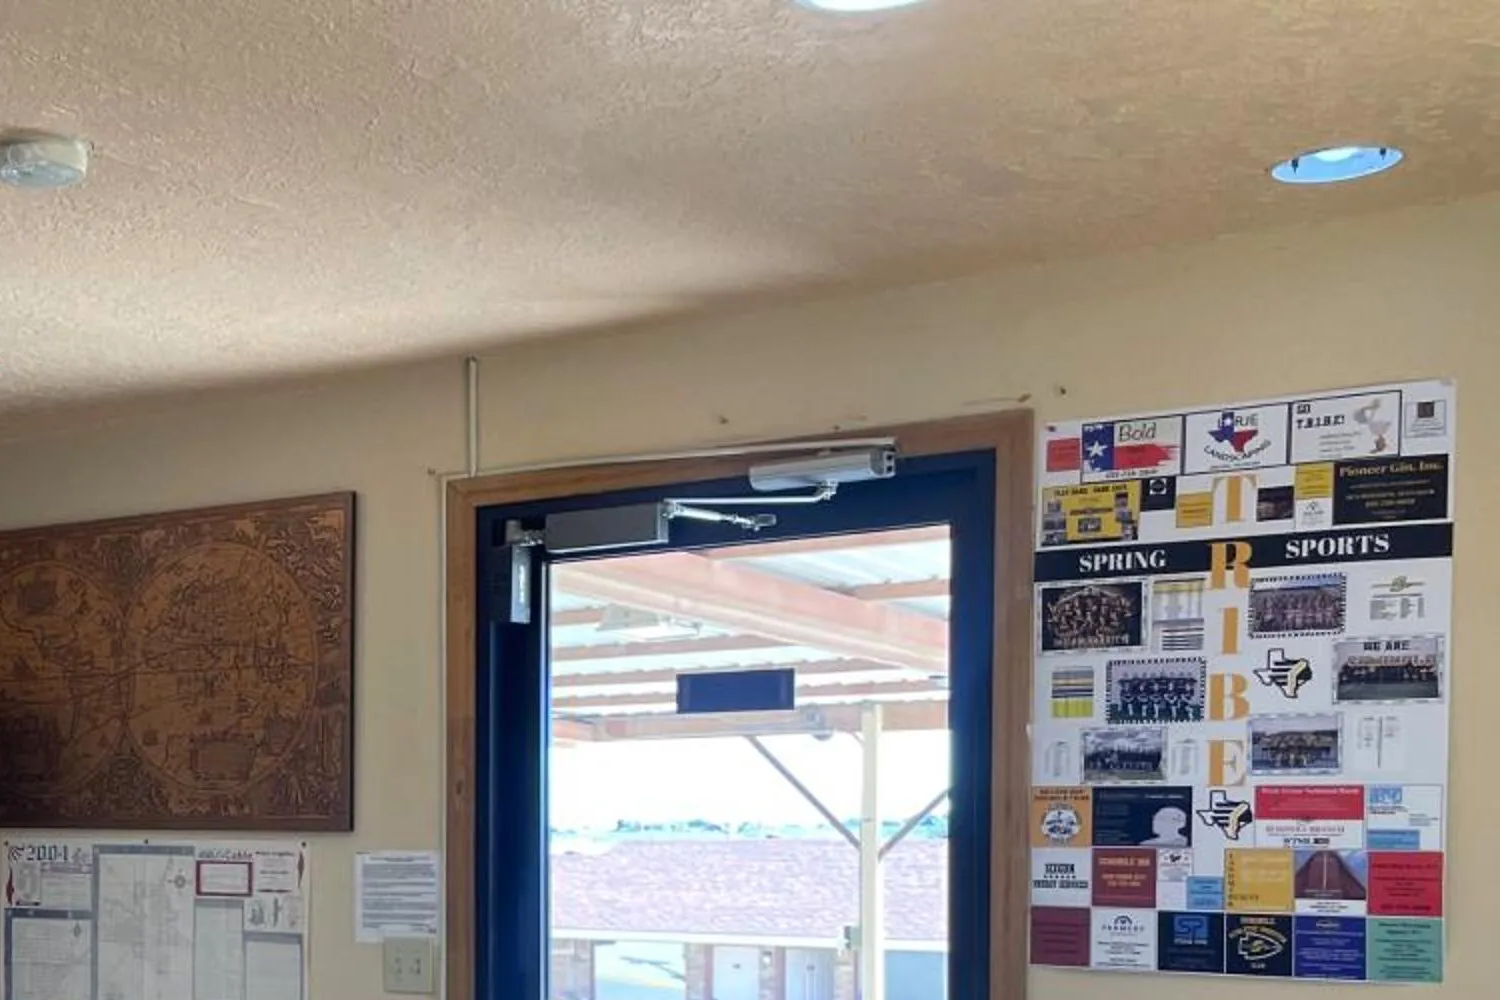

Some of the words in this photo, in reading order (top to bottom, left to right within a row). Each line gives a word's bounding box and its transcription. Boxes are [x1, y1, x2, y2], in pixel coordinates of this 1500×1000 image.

[1119, 421, 1156, 441] Bold
[1339, 464, 1387, 478] Pioneer
[1079, 549, 1167, 574] SPRING
[1285, 533, 1390, 559] SPORTS
